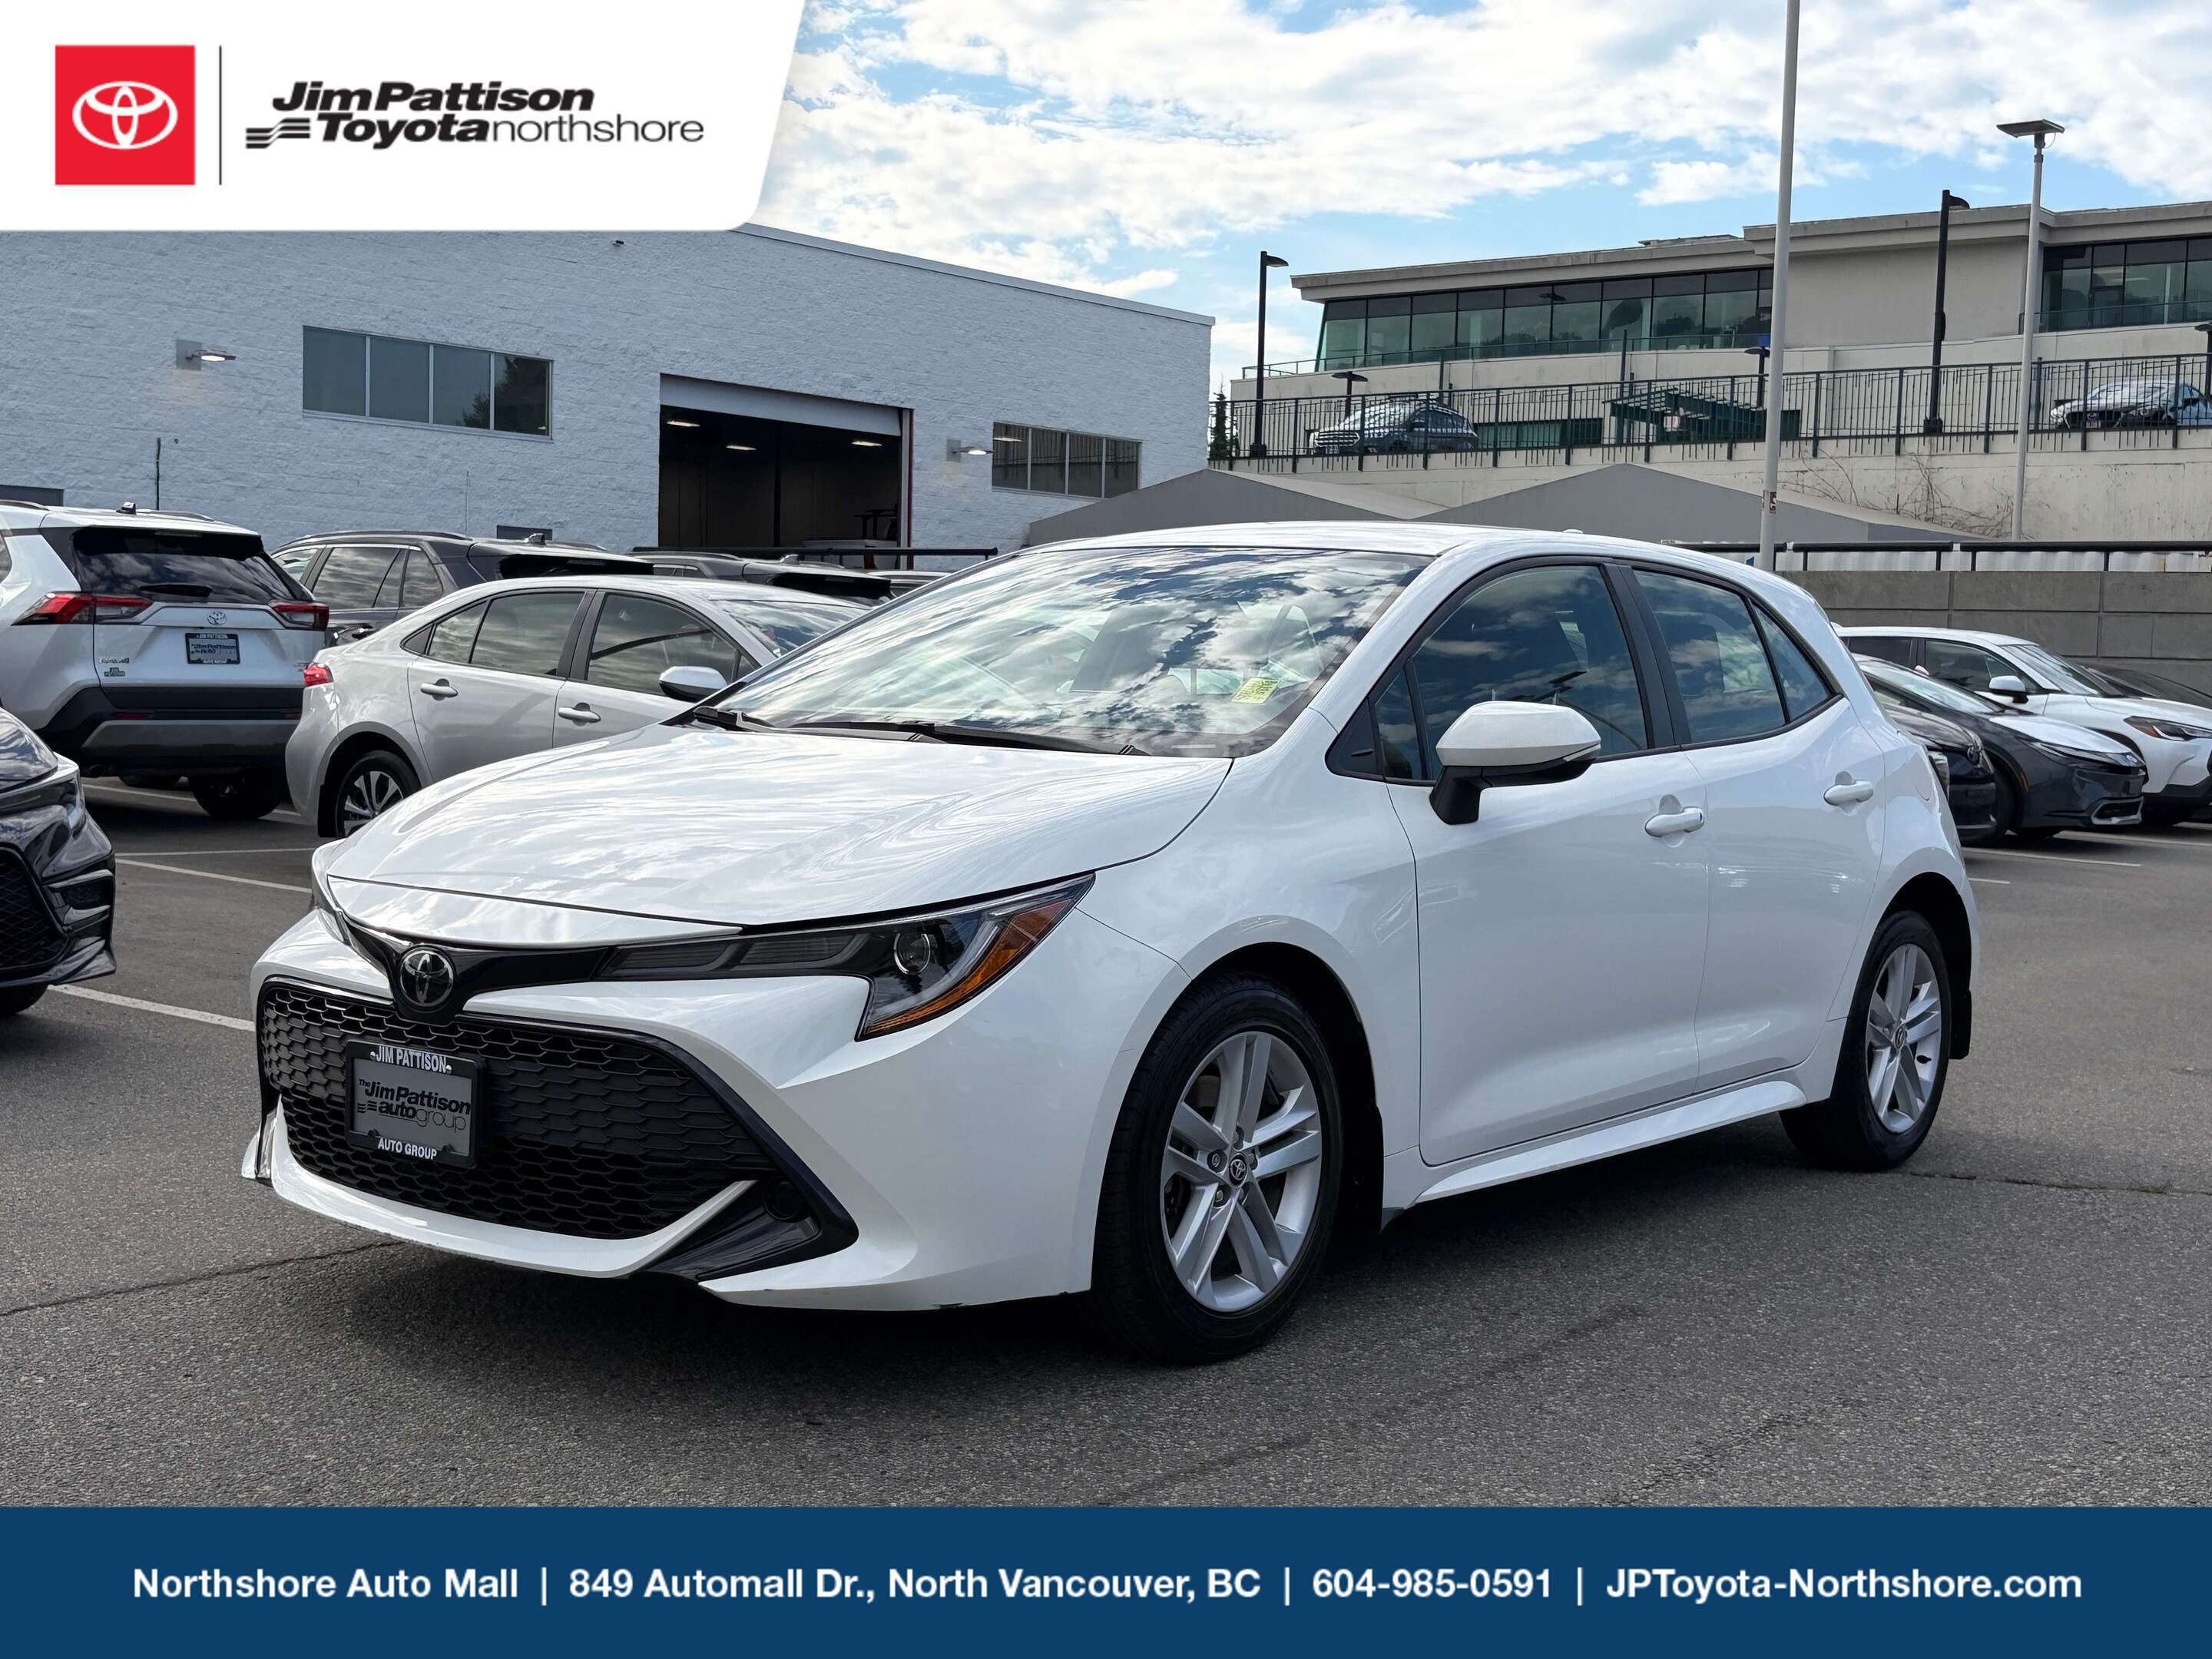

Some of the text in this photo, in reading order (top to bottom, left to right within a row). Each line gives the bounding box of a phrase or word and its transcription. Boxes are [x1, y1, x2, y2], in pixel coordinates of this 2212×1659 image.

[376, 1045, 447, 1074] JIM PATTISON
[377, 1137, 438, 1161] AUTO GROUP
